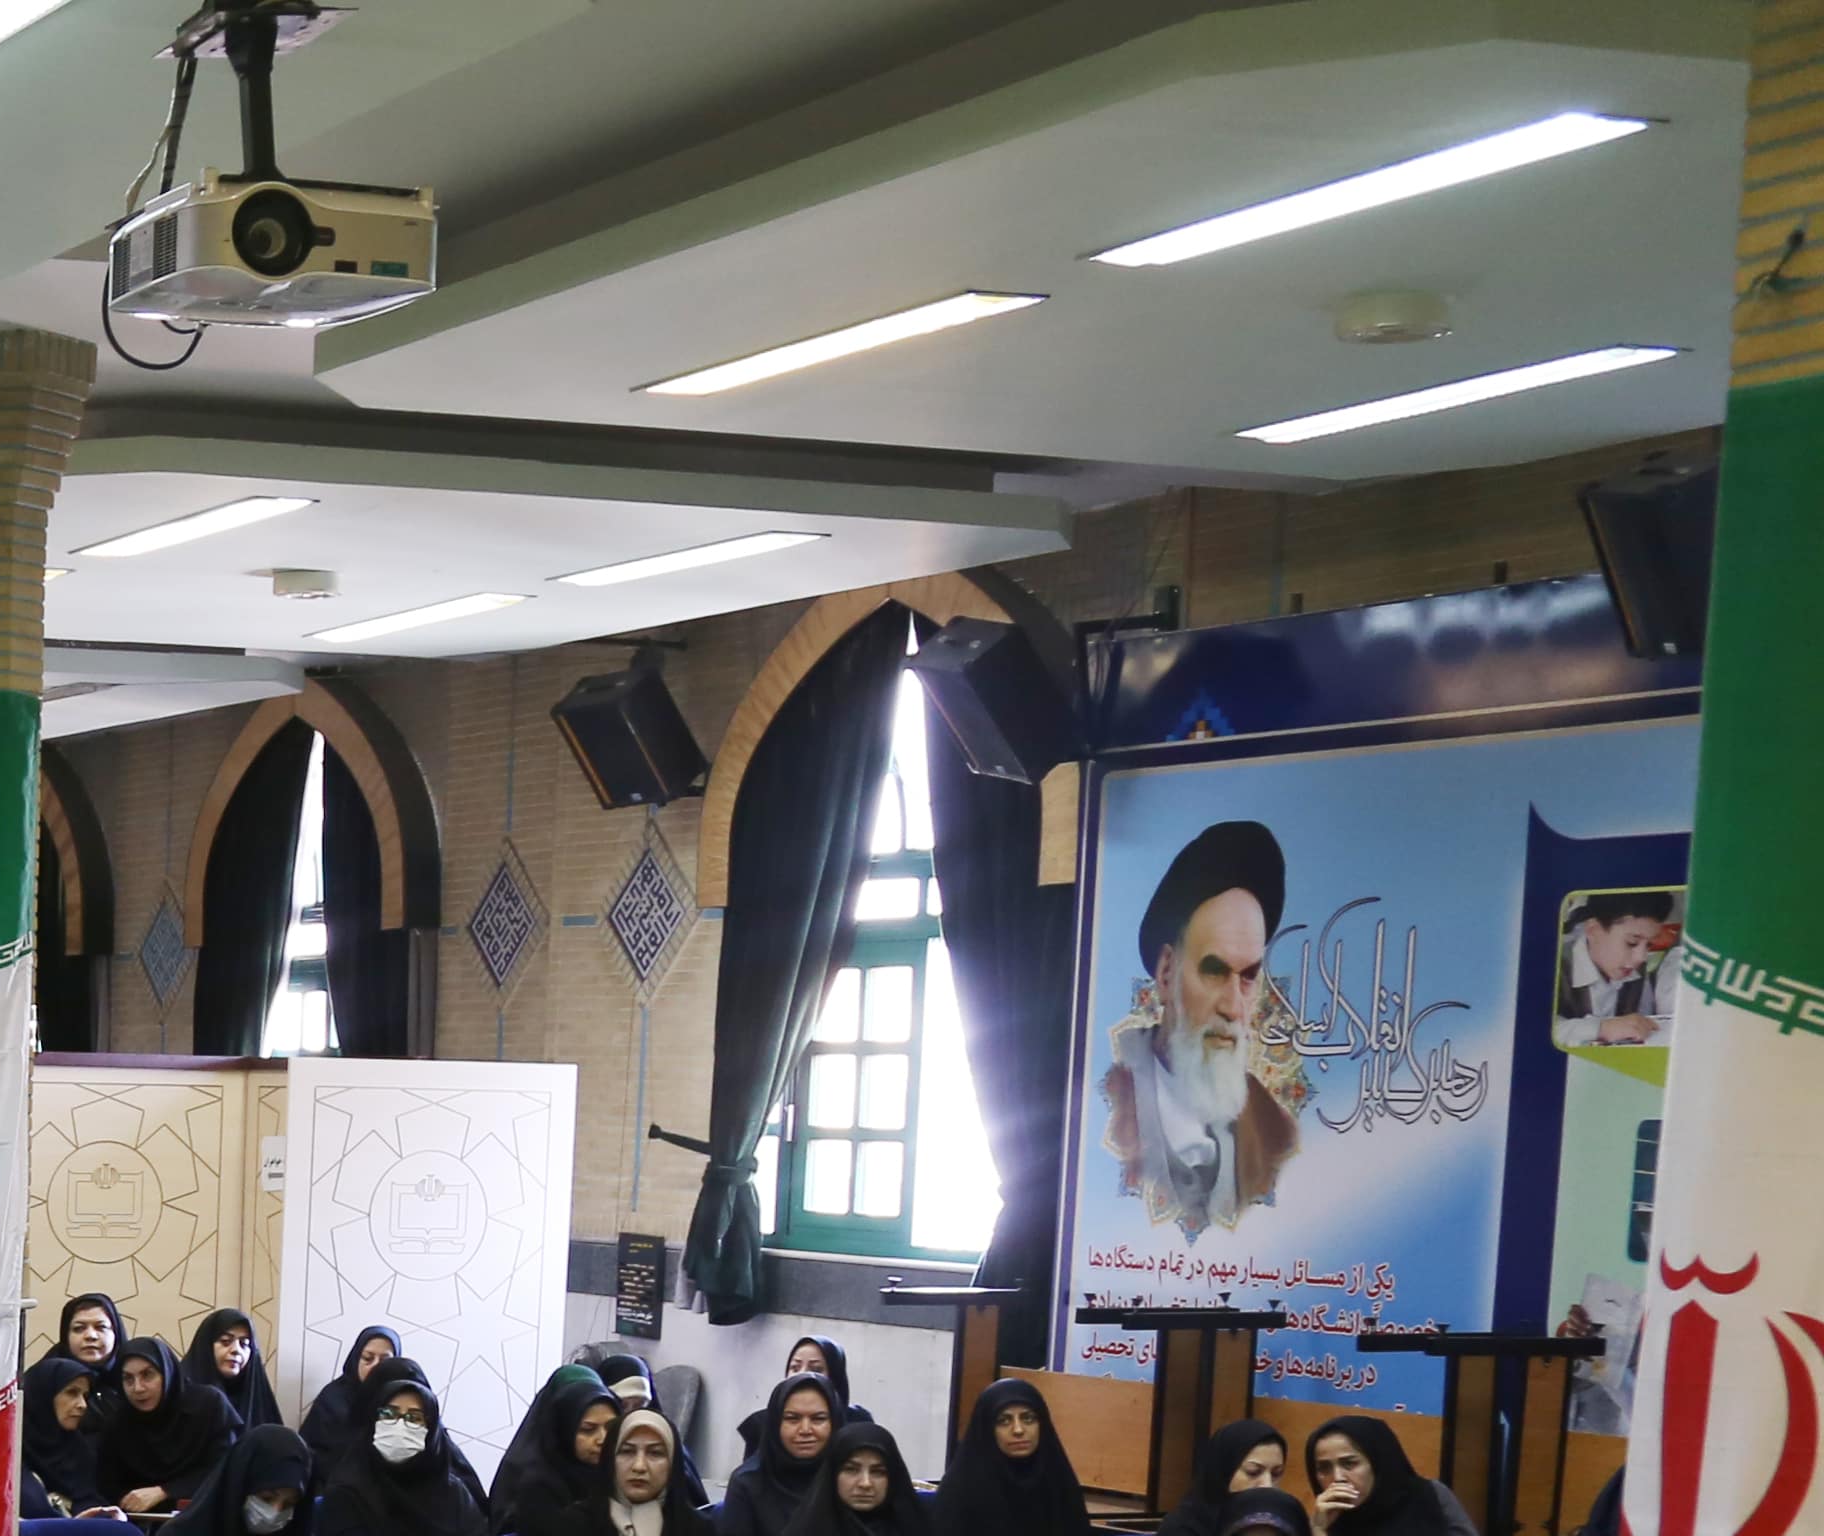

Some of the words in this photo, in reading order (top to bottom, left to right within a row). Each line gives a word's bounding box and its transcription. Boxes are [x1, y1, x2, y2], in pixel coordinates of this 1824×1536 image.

[1159, 1251, 1184, 1286] تمام
[1186, 1259, 1204, 1280] در
[1209, 1262, 1238, 1288] مهم
[1239, 1256, 1281, 1289] بسیار
[1285, 1261, 1346, 1287] مسائل
[1348, 1265, 1364, 1294] از
[1367, 1265, 1394, 1298] یکی
[1082, 1331, 1135, 1361] تحصیلی
[1353, 1364, 1377, 1389] در
